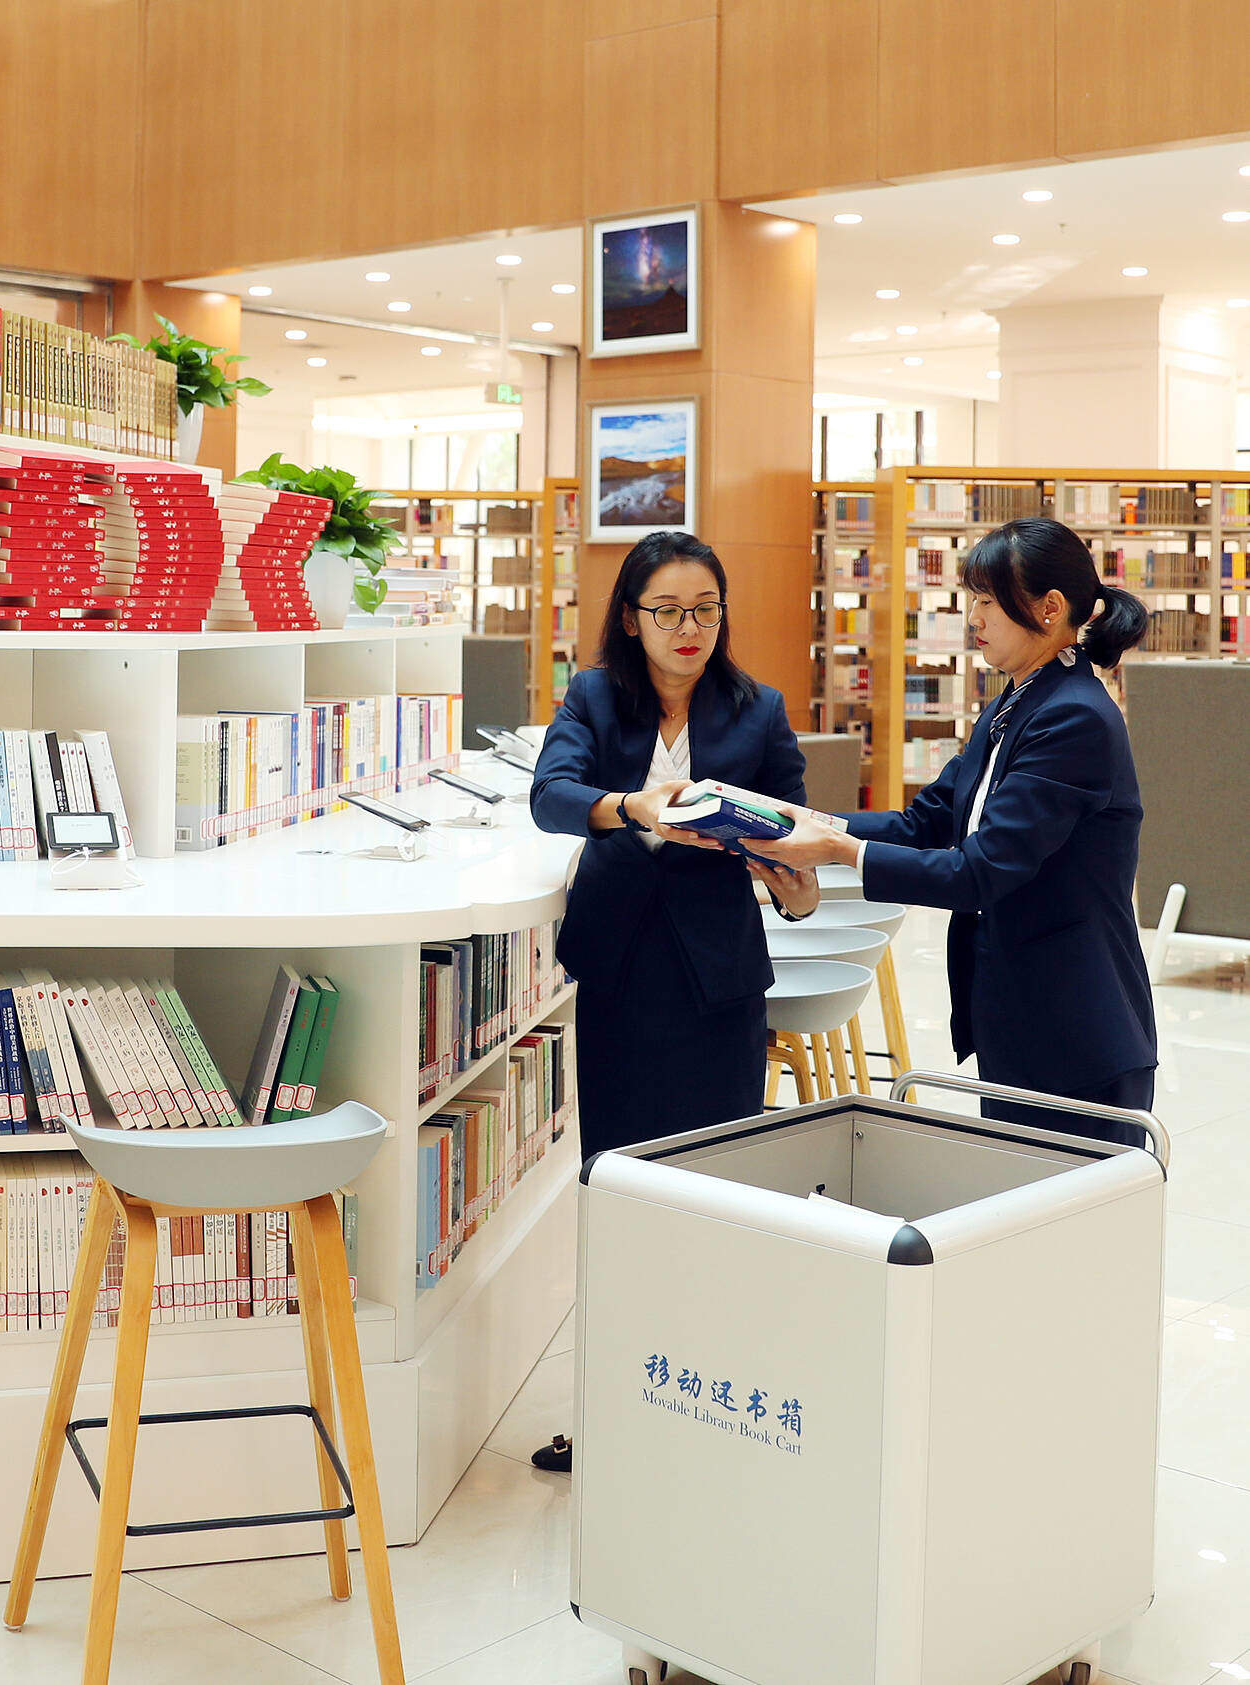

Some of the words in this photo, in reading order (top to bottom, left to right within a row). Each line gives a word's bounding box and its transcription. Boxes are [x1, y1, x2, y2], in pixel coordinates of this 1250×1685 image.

[642, 1388, 690, 1416] Movable
[694, 1406, 736, 1435] Library
[739, 1422, 772, 1446] Book
[776, 1435, 802, 1456] Cart
[644, 1354, 803, 1437] 移动还书箱
